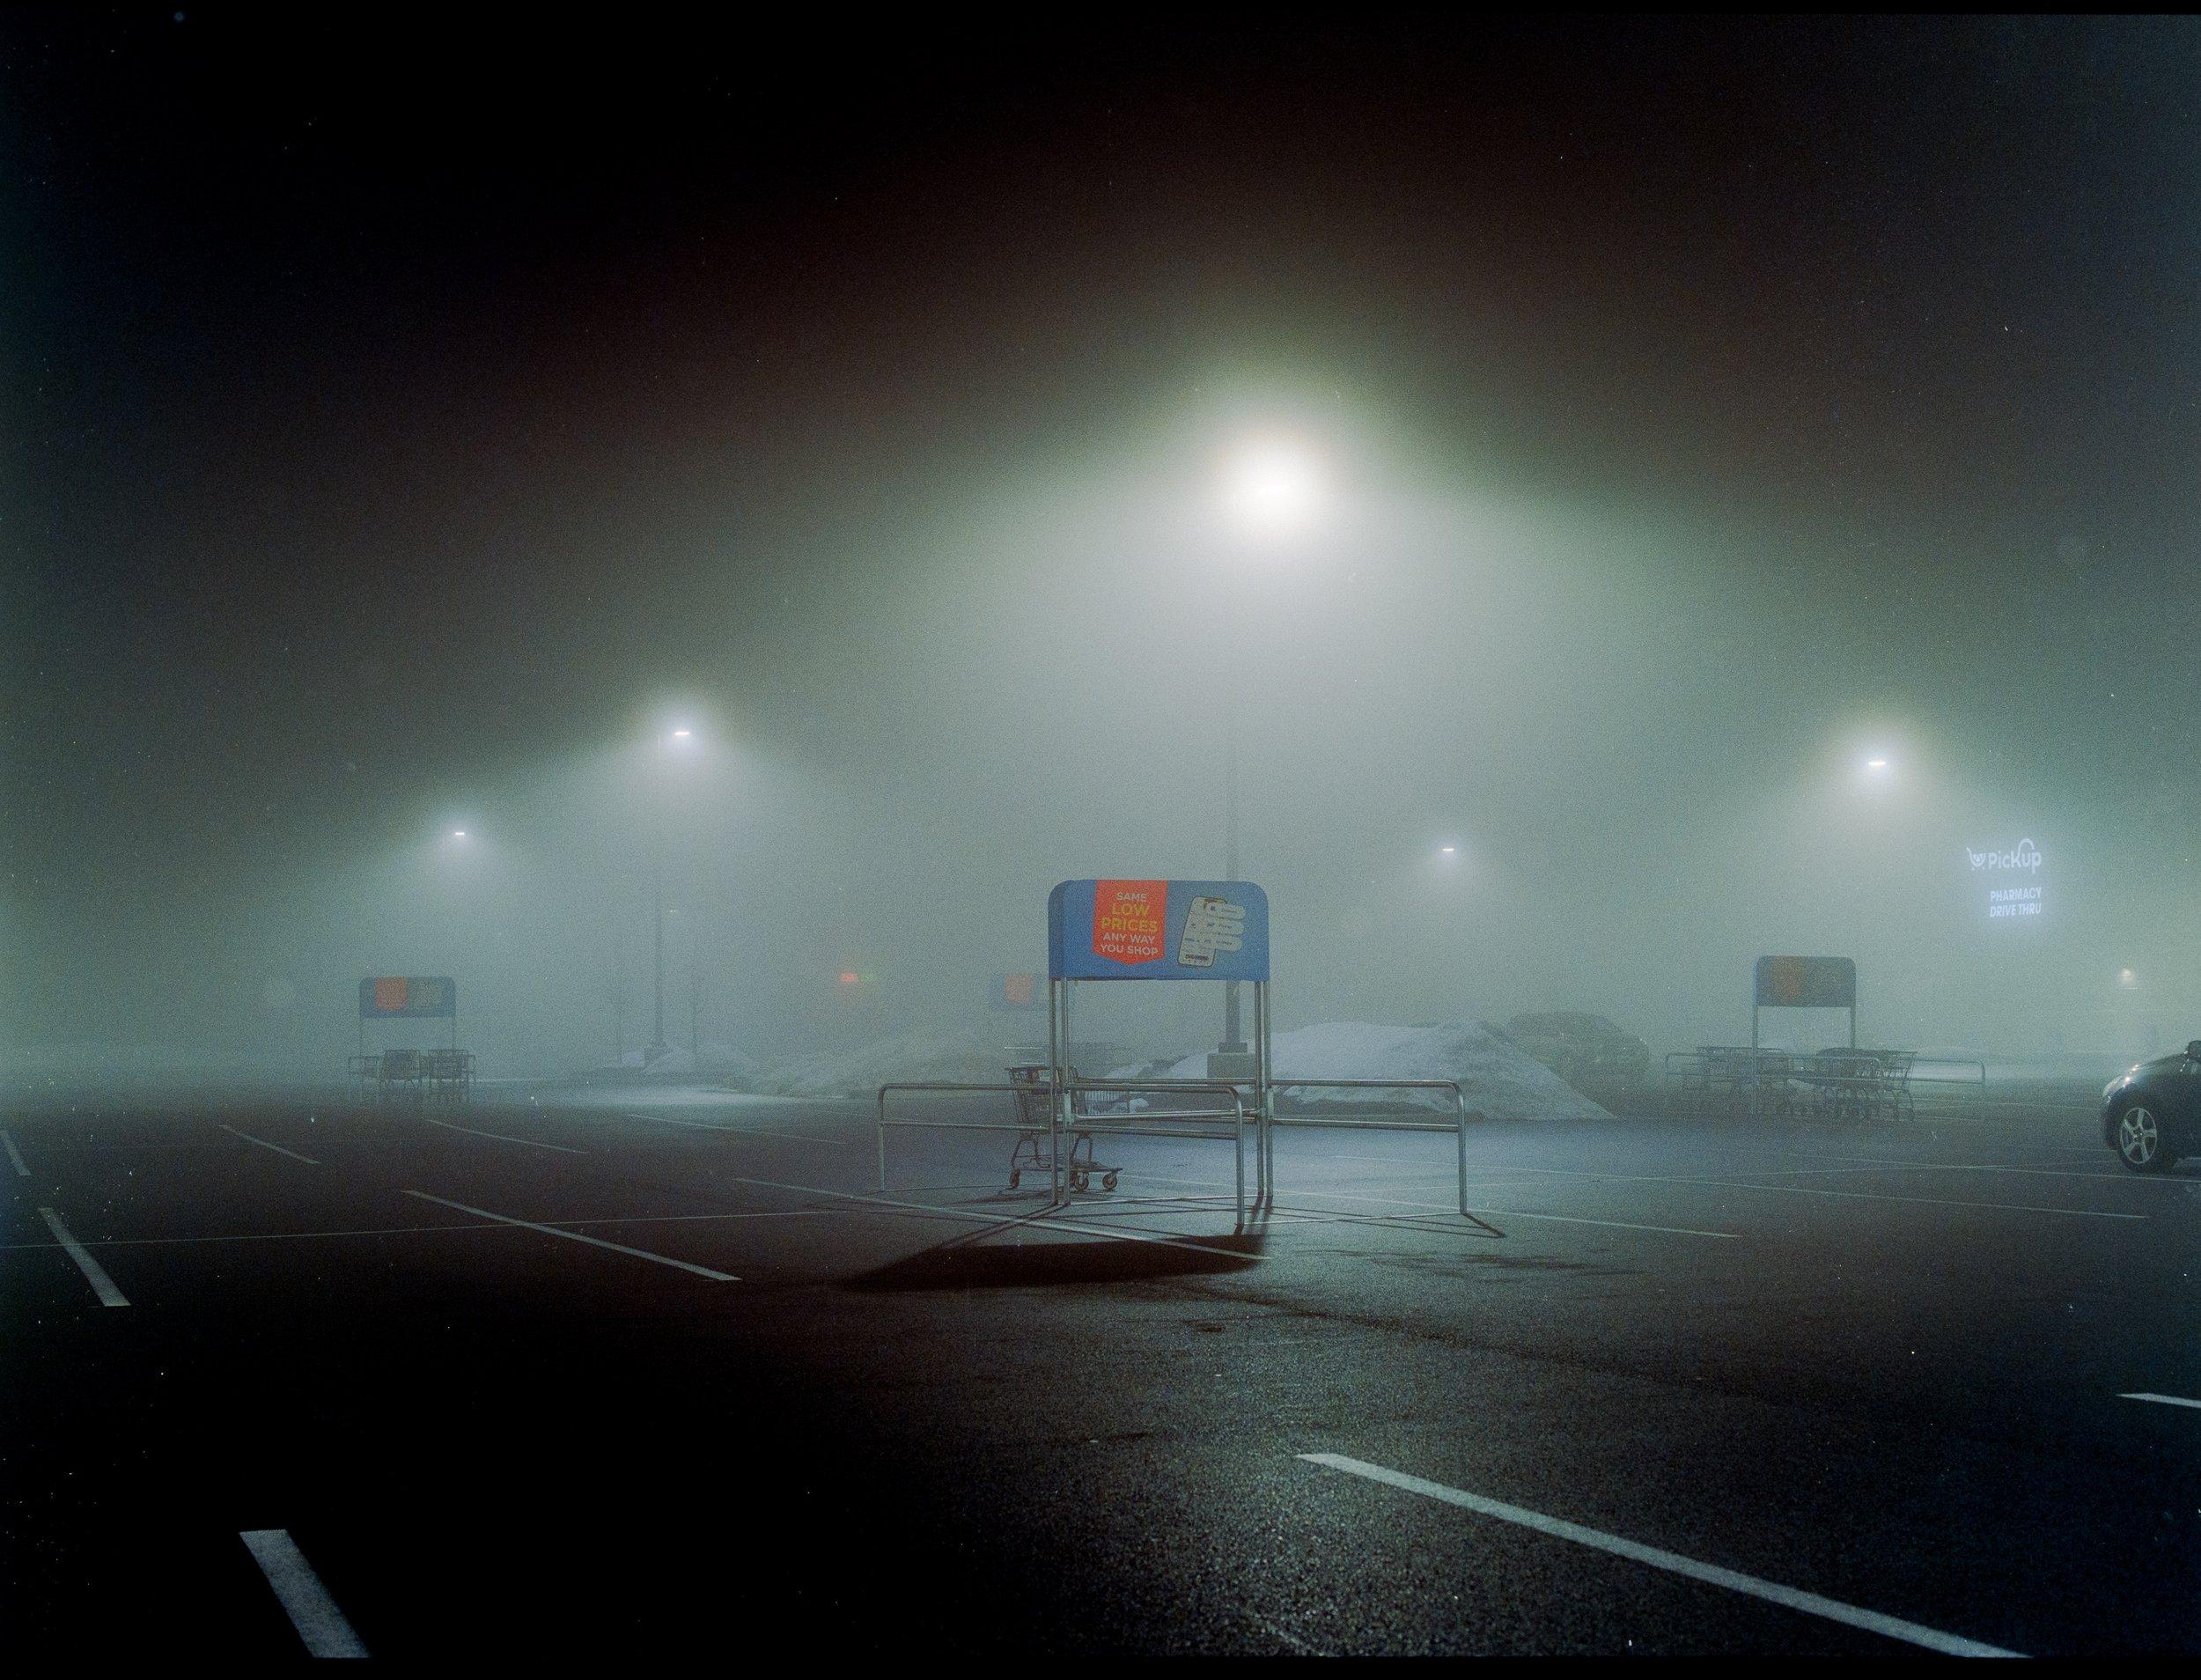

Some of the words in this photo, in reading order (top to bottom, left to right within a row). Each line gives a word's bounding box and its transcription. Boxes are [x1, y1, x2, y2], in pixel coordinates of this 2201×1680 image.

[1116, 892, 1146, 902] SAME
[1990, 888, 2042, 902] PHARMACY
[1112, 903, 1150, 916] LOW
[1990, 904, 2015, 917] DRIVE
[2019, 903, 2042, 915] THRU
[1101, 916, 1158, 932] PRICES
[1102, 932, 1127, 942] ANY
[1130, 934, 1155, 944] WAY
[1100, 944, 1124, 953] YOU
[1127, 946, 1159, 955] SHOP
